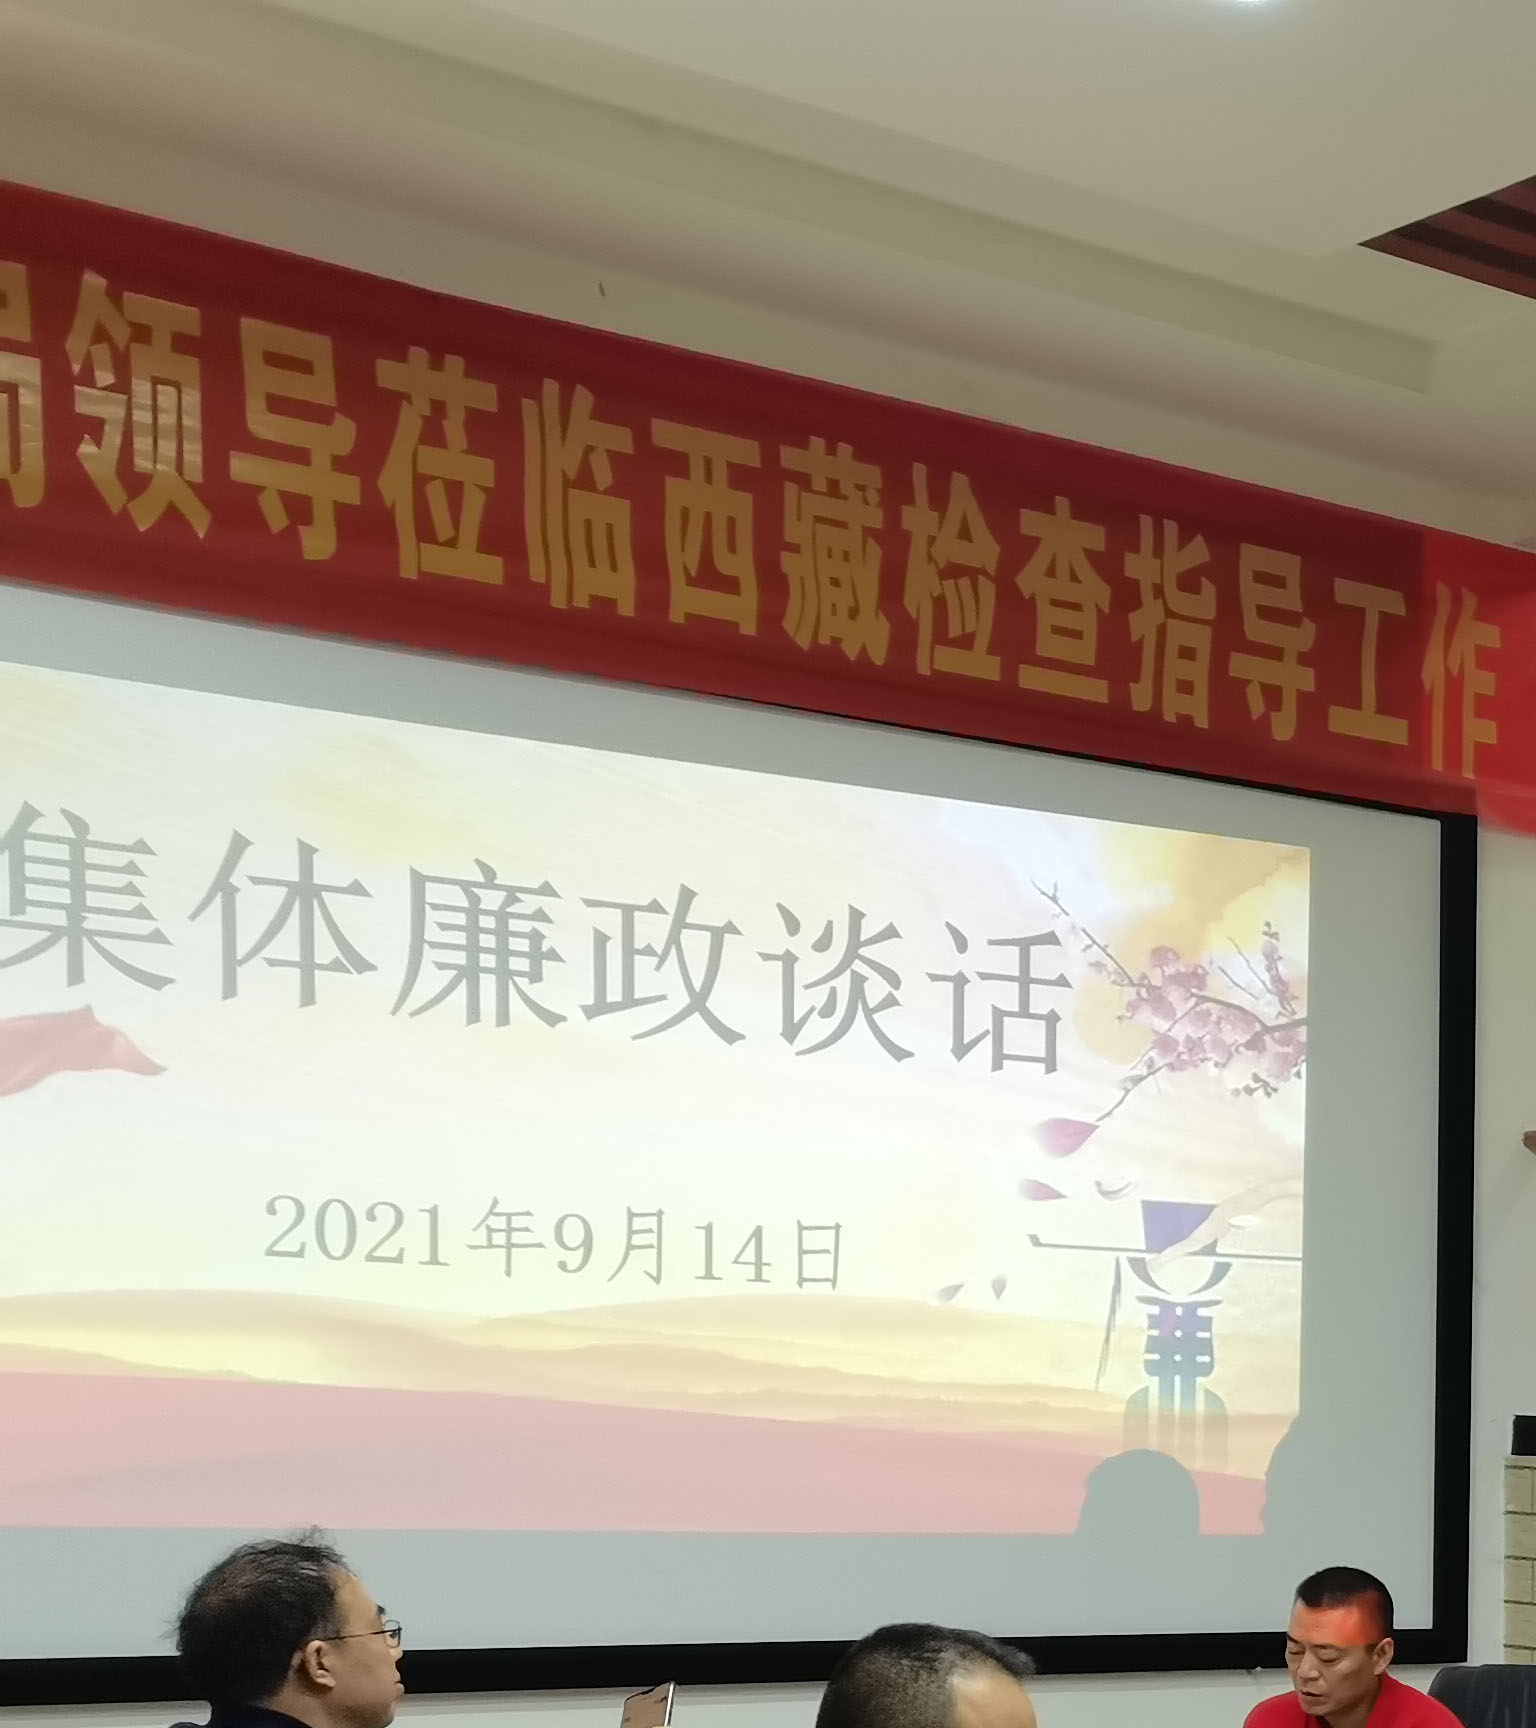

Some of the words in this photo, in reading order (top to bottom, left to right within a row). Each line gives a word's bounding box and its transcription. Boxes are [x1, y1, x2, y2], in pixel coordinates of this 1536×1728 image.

[0, 800, 1073, 1075] 集体廉政谈话
[263, 1194, 843, 1292] 2021年9月14日
